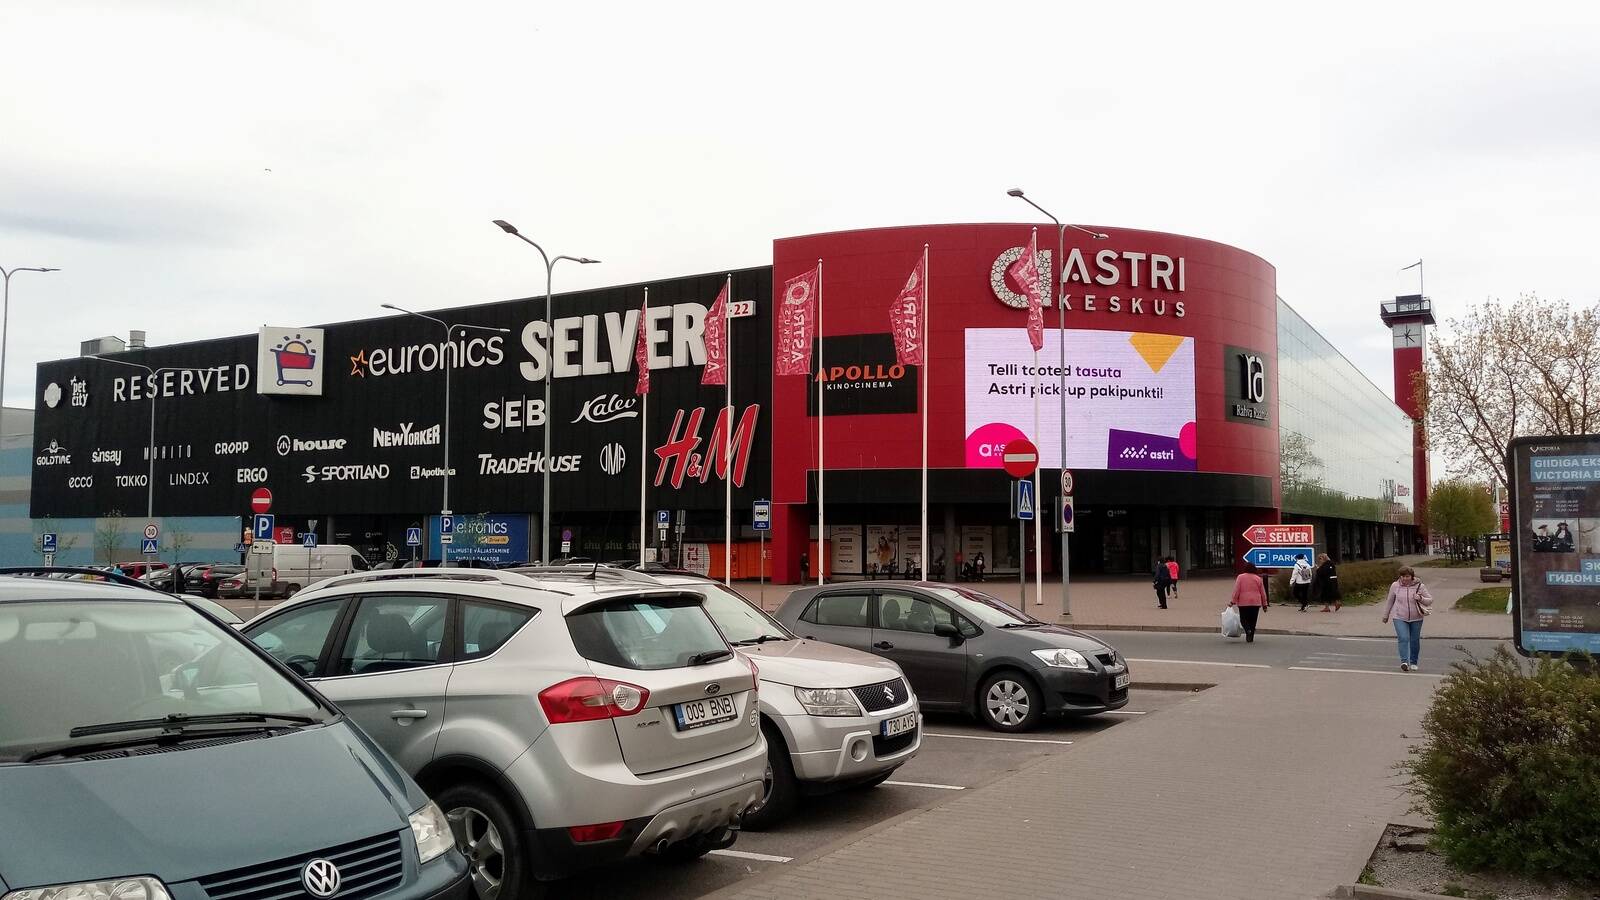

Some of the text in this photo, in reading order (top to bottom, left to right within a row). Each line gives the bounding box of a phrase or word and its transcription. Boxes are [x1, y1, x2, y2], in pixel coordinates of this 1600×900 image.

[1060, 248, 1185, 291] ASTRI
[1059, 294, 1185, 317] KESKUS
[519, 302, 710, 382] SELVER
[368, 331, 504, 377] euronics
[815, 364, 905, 382] APOLLO
[988, 364, 1122, 378] Telli tooted tasuta
[73, 380, 87, 395] pet
[113, 364, 250, 402] RESERVED
[988, 382, 1026, 395] Astri
[1090, 385, 1164, 400] pakipunkti!
[71, 392, 89, 407] city
[483, 399, 546, 430] SEB
[570, 393, 638, 423] Kalev
[214, 441, 249, 455] CROPP
[293, 438, 347, 451] house
[654, 403, 760, 489] H&M
[92, 448, 122, 466] sinsay
[143, 445, 191, 460] MOHITO
[1150, 449, 1174, 460] astri
[1534, 458, 1579, 468] GIIDIGA
[169, 472, 209, 486] LINDEX
[237, 467, 268, 483] ERGO
[321, 464, 390, 480] SPORTLAND
[1535, 470, 1591, 480] VICTORIA
[68, 475, 93, 488] ecco
[258, 517, 270, 537] P
[443, 518, 451, 532] P
[1269, 531, 1309, 543] SELVER
[1272, 554, 1309, 562] PARKA
[1549, 574, 1592, 584] ГИДОМ
[685, 696, 732, 721] 009 BNB
